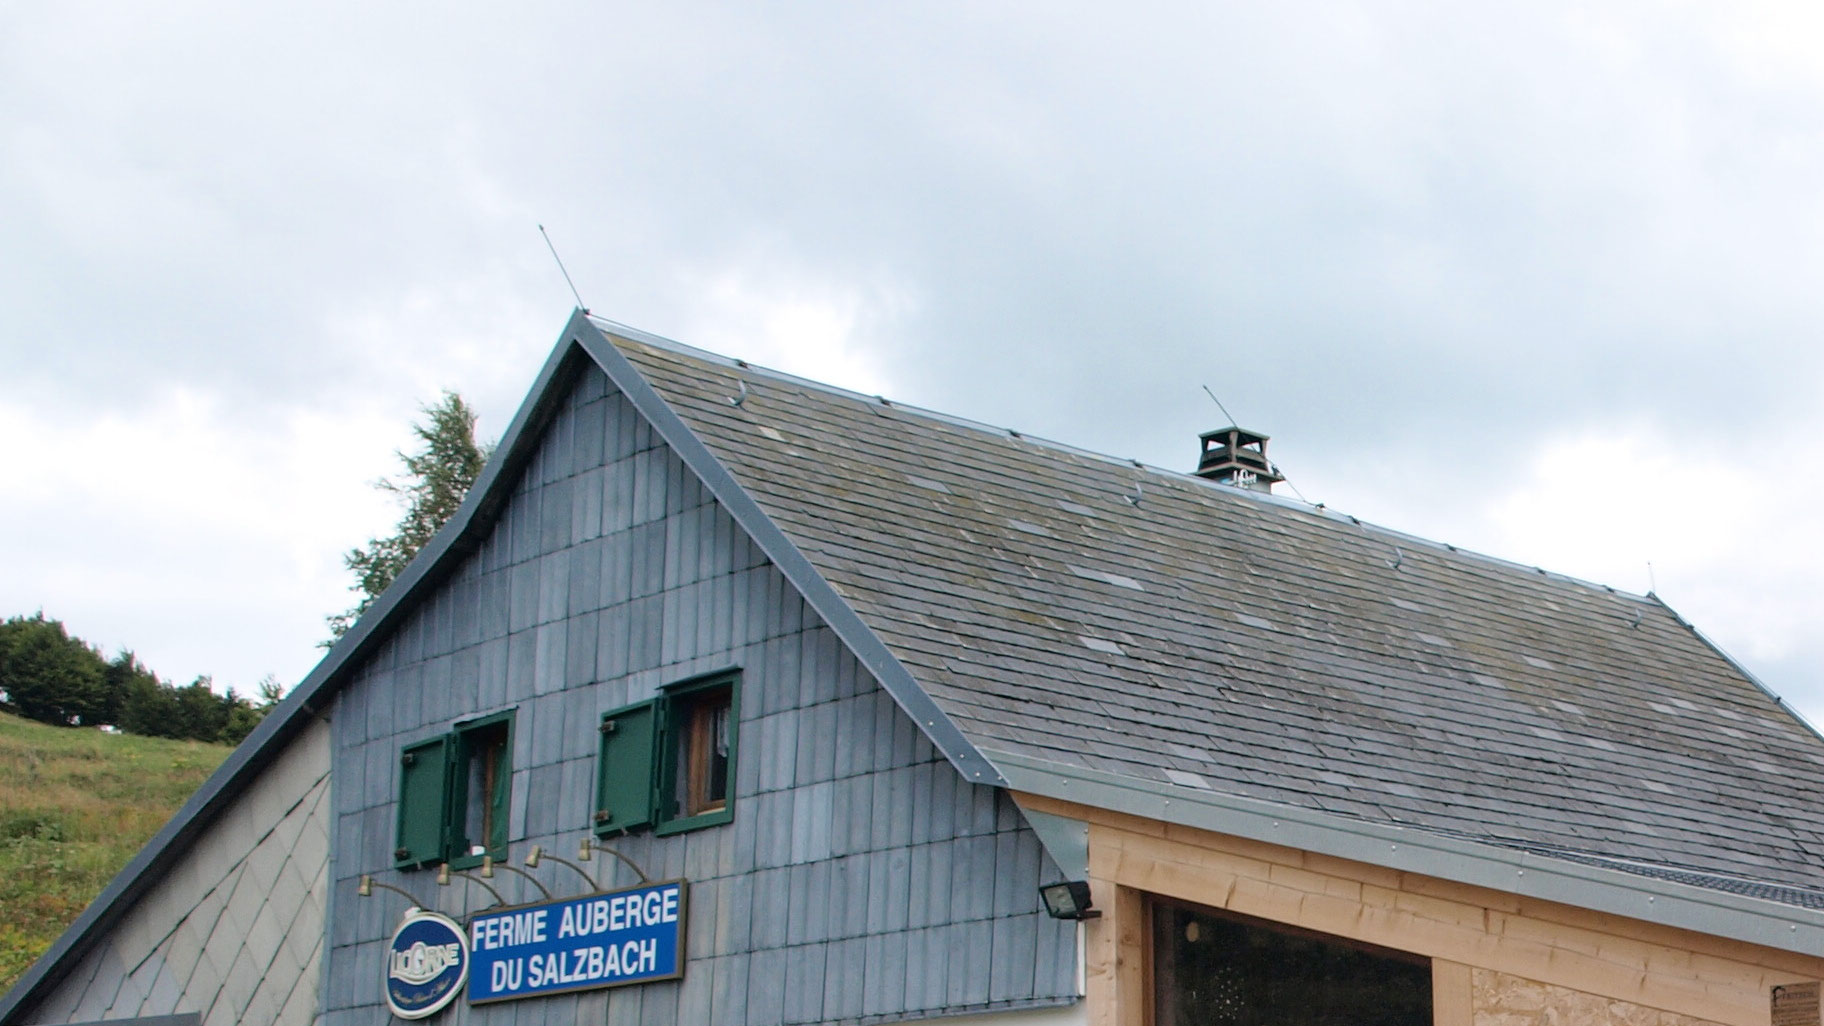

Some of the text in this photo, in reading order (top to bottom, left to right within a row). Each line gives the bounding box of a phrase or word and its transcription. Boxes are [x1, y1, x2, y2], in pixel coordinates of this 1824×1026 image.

[472, 888, 679, 951] FERME AUBERGE
[491, 957, 523, 992] DU
[528, 938, 657, 988] SALZBACH
